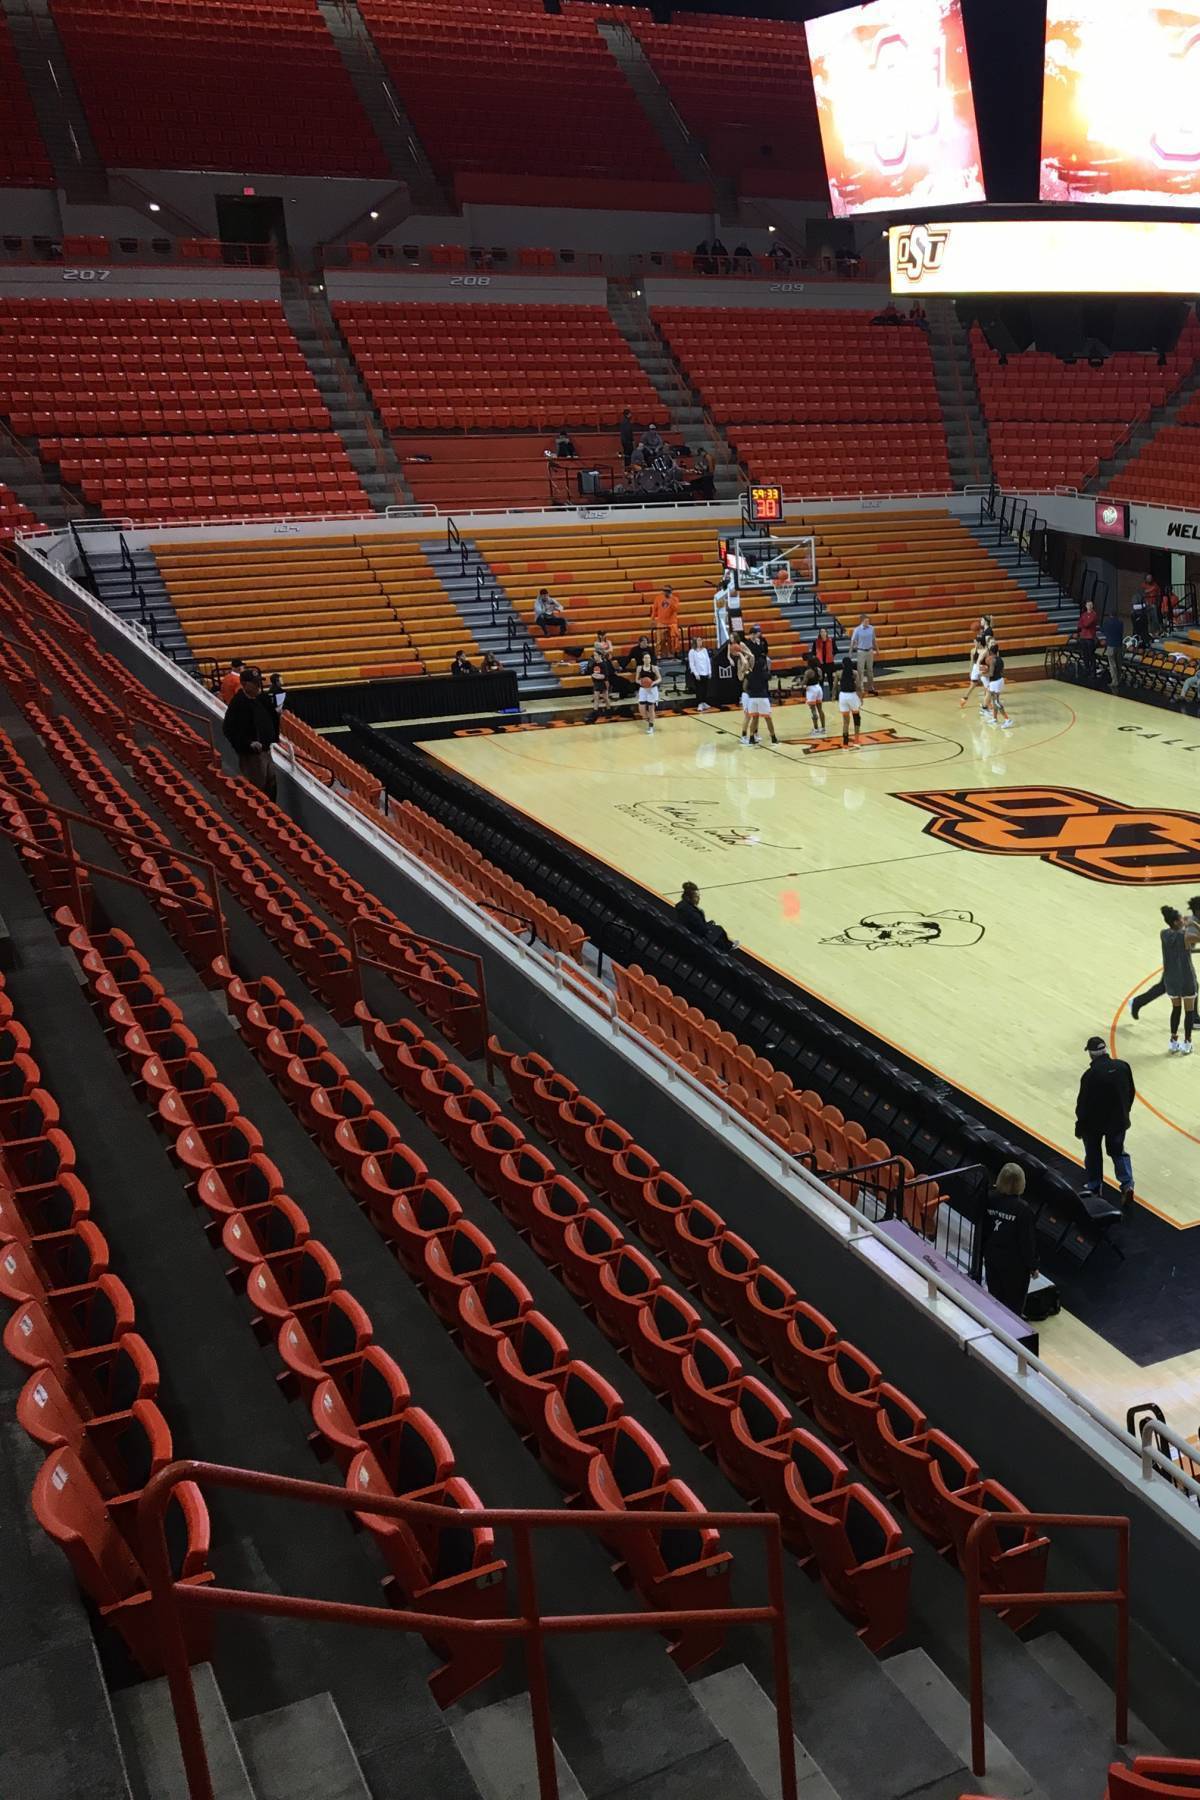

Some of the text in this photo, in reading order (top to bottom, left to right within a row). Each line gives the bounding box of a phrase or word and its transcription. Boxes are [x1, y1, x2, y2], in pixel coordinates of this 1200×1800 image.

[63, 270, 111, 280] 207
[450, 275, 491, 286] 208
[770, 283, 804, 292] 209
[751, 488, 779, 499] 59:33
[756, 500, 776, 516] 30
